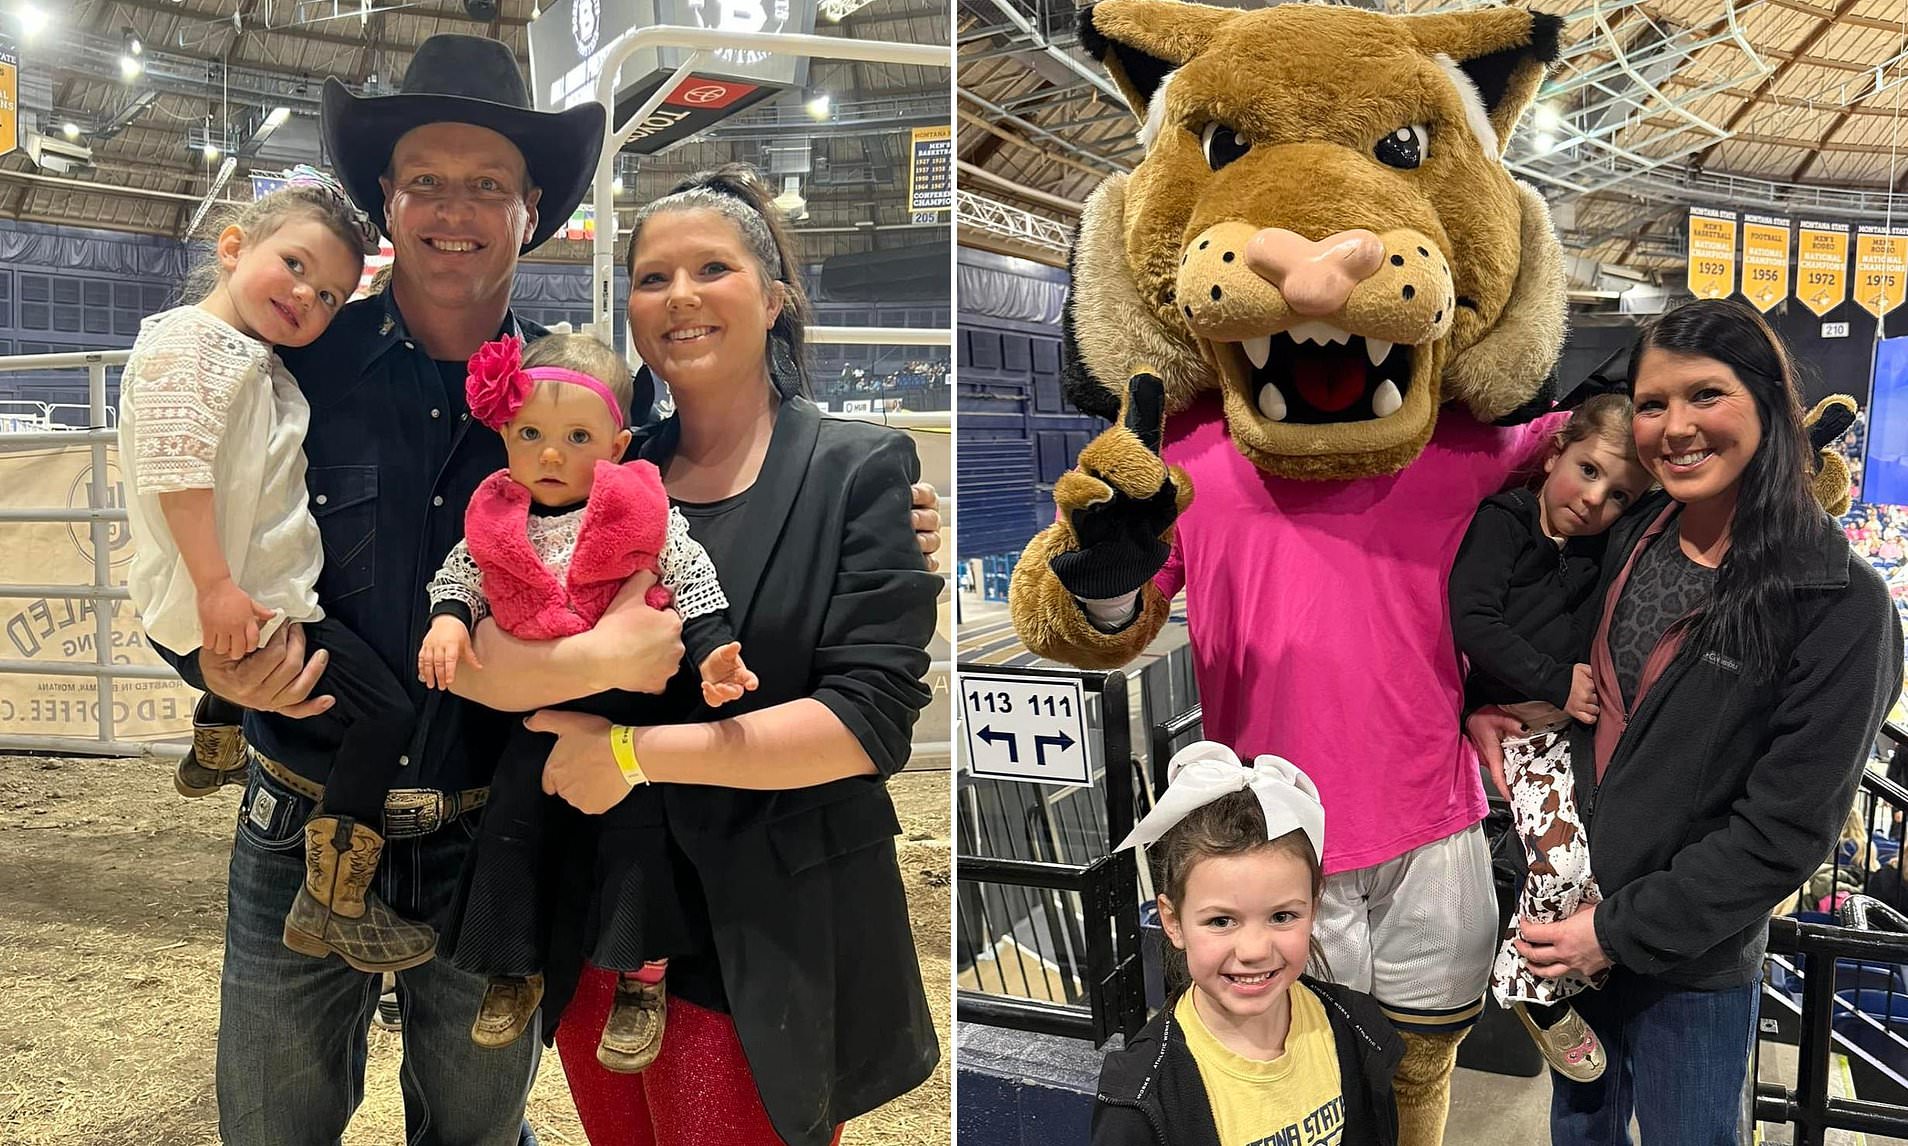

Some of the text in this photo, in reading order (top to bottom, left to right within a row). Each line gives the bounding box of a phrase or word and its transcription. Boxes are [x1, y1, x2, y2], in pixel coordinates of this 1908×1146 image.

[915, 212, 936, 224] 205
[1751, 231, 1783, 242] FOOTBALL
[1699, 261, 1725, 276] 1929
[1752, 268, 1779, 282] 1956
[1808, 272, 1836, 286] 1972
[1825, 324, 1845, 336] 210
[968, 690, 1072, 718] 113 111
